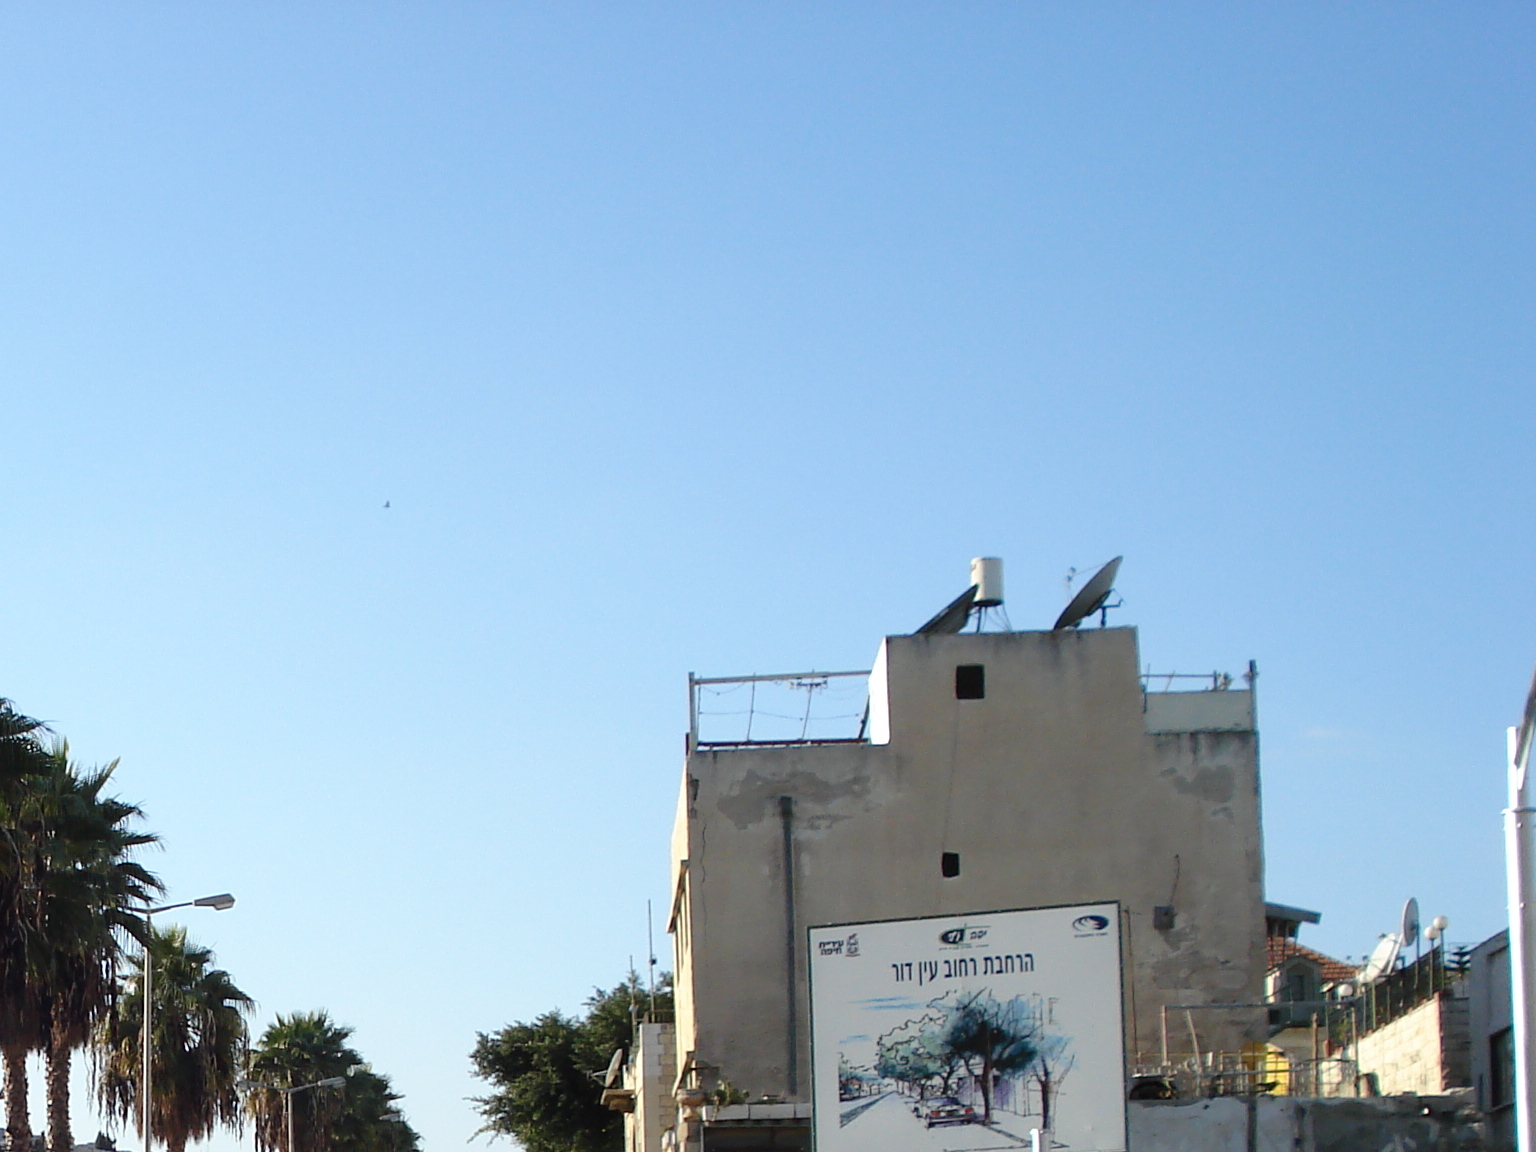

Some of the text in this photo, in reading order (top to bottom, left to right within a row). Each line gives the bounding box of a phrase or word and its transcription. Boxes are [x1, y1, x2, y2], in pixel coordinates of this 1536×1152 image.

[891, 952, 1035, 986] הרחבת רחוב עין דור
